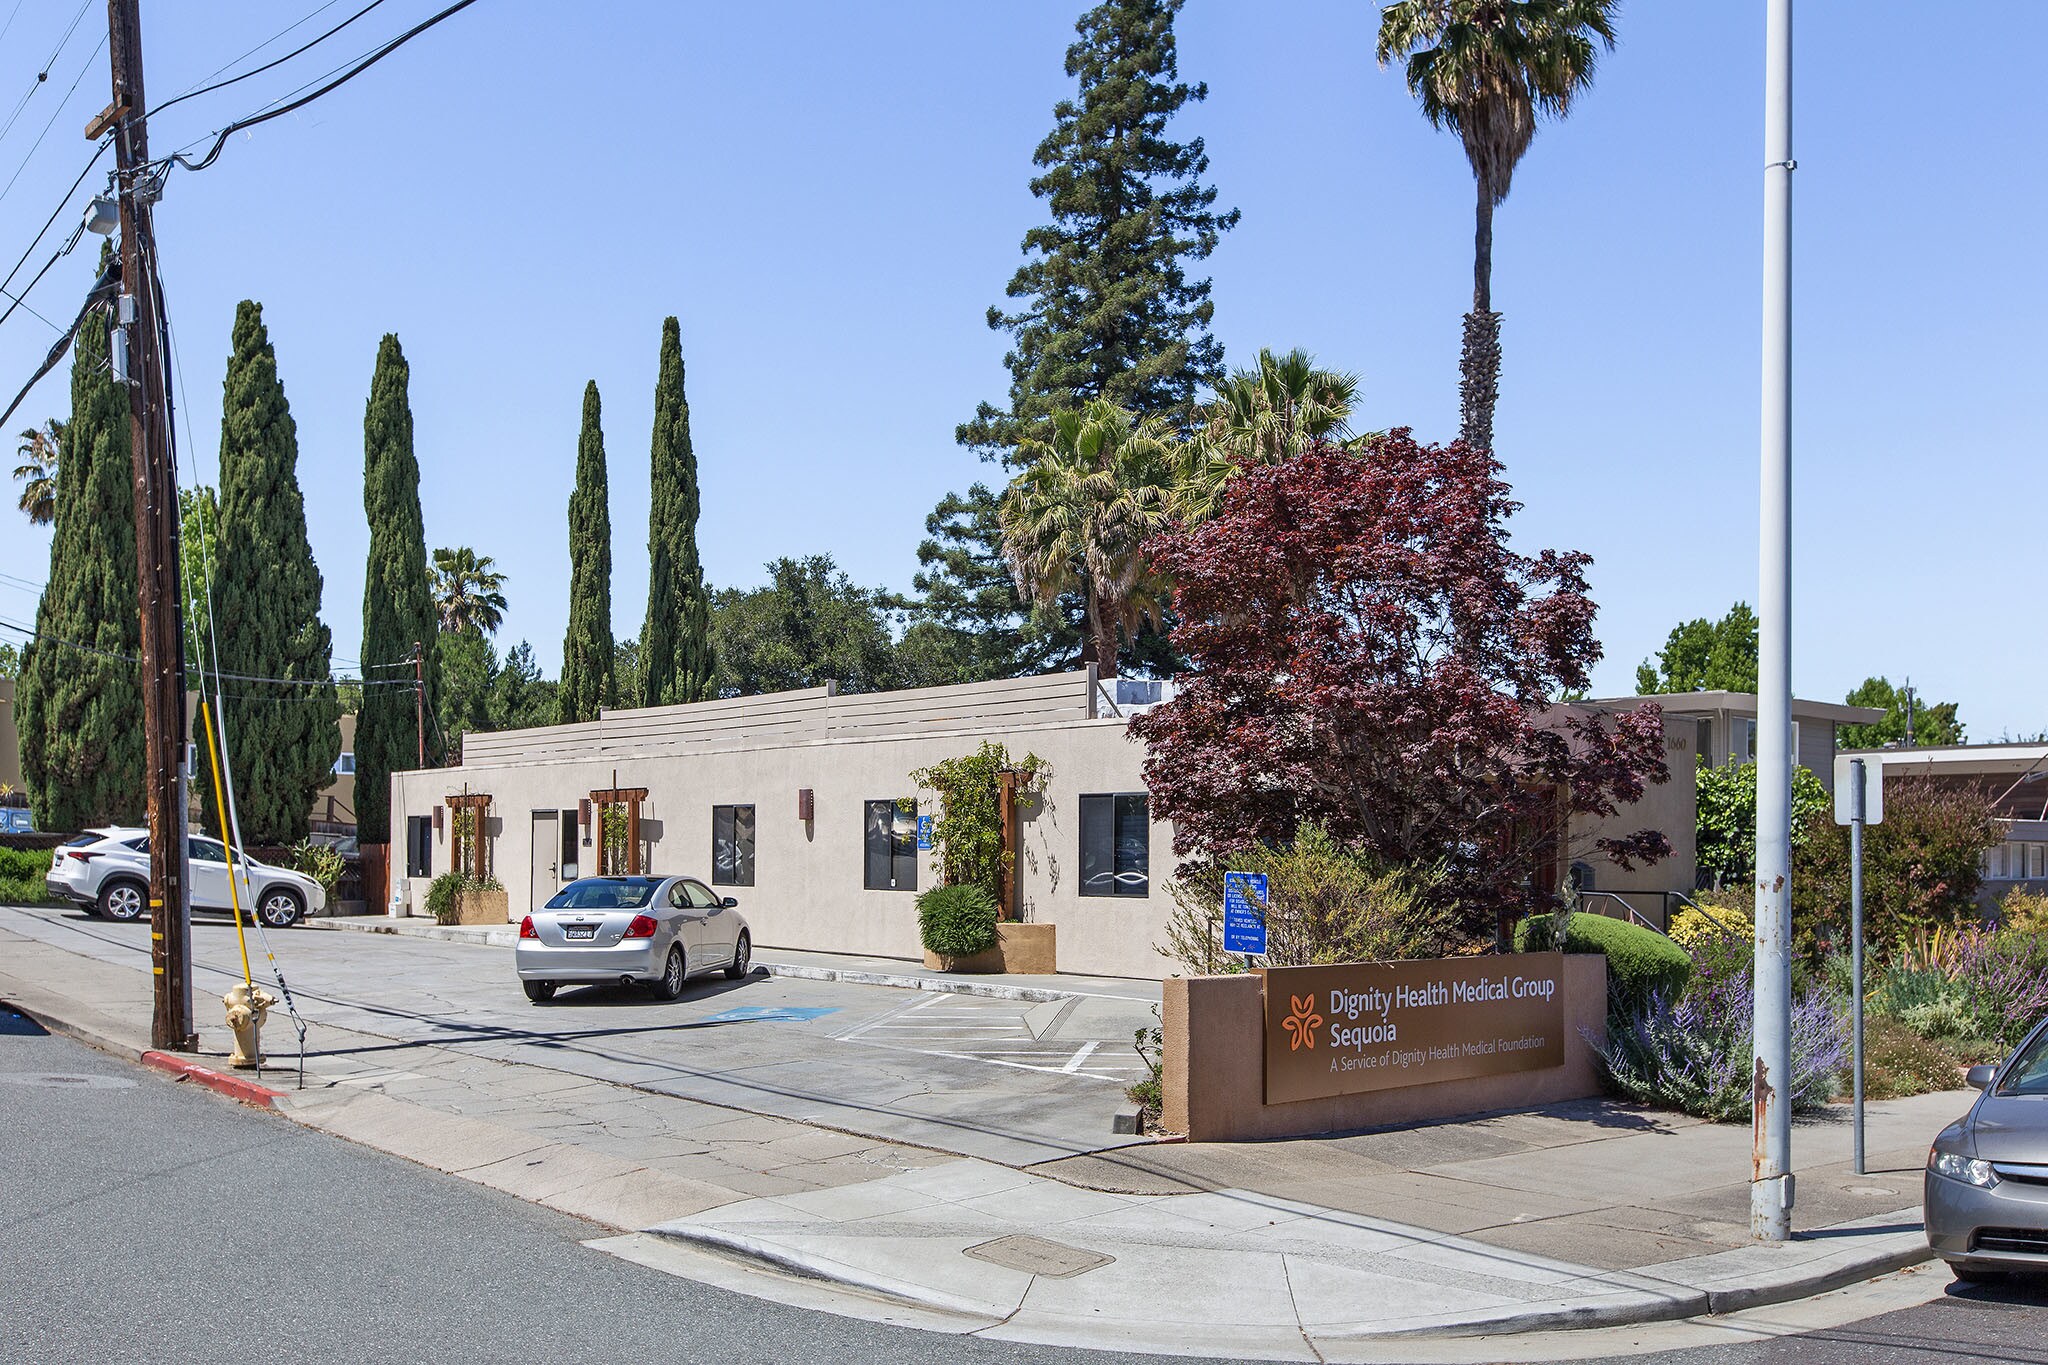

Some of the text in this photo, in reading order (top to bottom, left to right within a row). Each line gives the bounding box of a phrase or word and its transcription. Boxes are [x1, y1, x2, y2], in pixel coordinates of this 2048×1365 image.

[1667, 737, 1686, 750] 1660
[1330, 976, 1555, 1019] Dignity Health Medical Group
[1330, 1018, 1397, 1052] Sequoia
[1329, 1035, 1545, 1072] A Service of Dignity Health Medical Foundation
